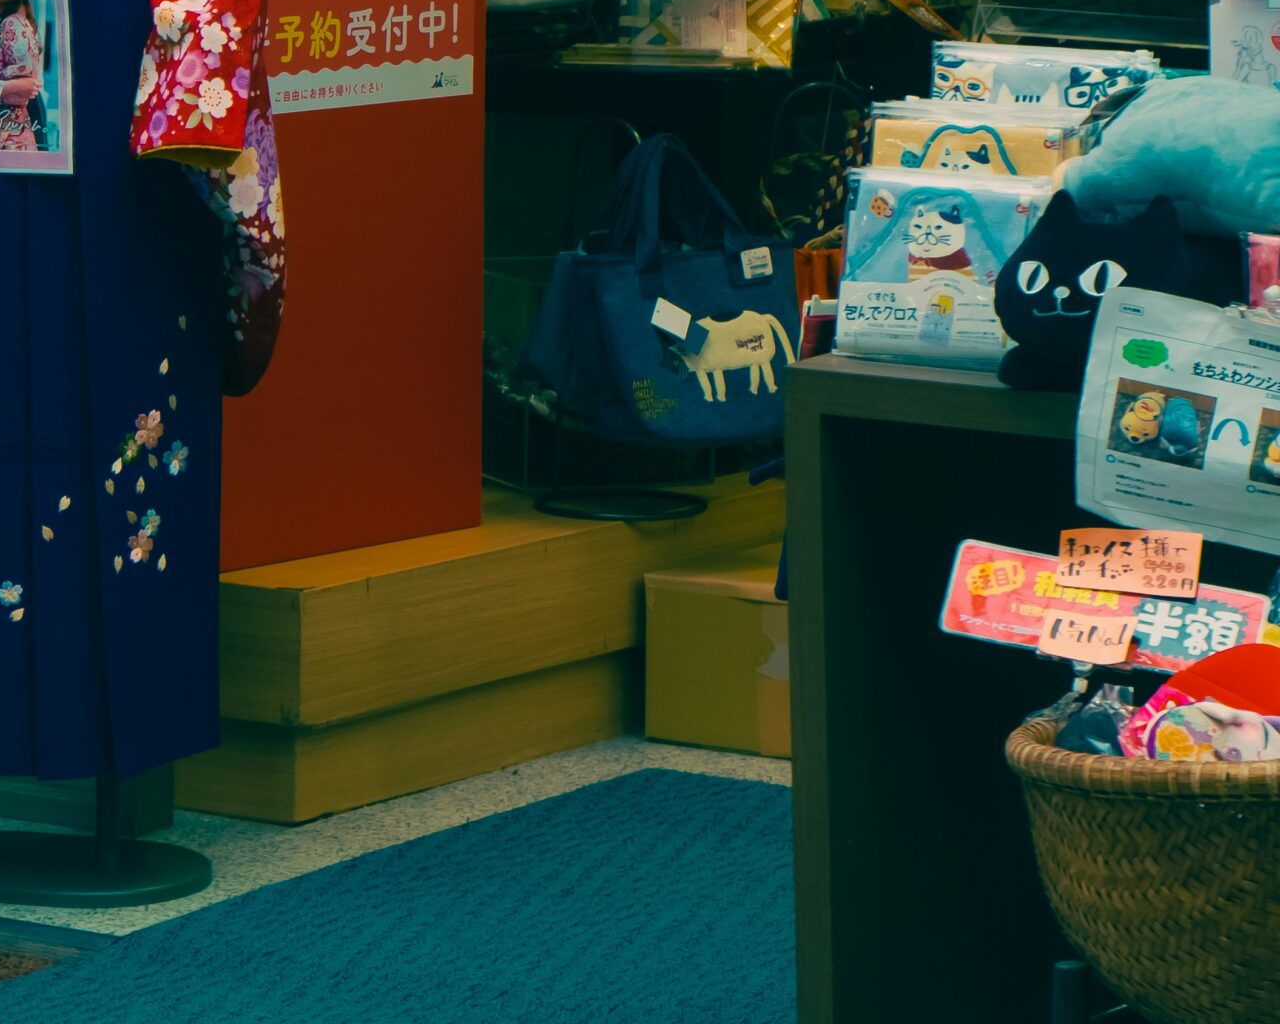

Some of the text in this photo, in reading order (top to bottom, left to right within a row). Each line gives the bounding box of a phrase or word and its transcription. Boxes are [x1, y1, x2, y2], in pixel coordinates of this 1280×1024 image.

[275, 0, 459, 64] 予約受付中!
[274, 82, 384, 103] ご自由にお持ち帰りください
[867, 291, 898, 303] くすぐる
[844, 302, 919, 322] 包んでクロス
[971, 564, 1019, 592] 注目!
[1135, 602, 1245, 657] 半額
